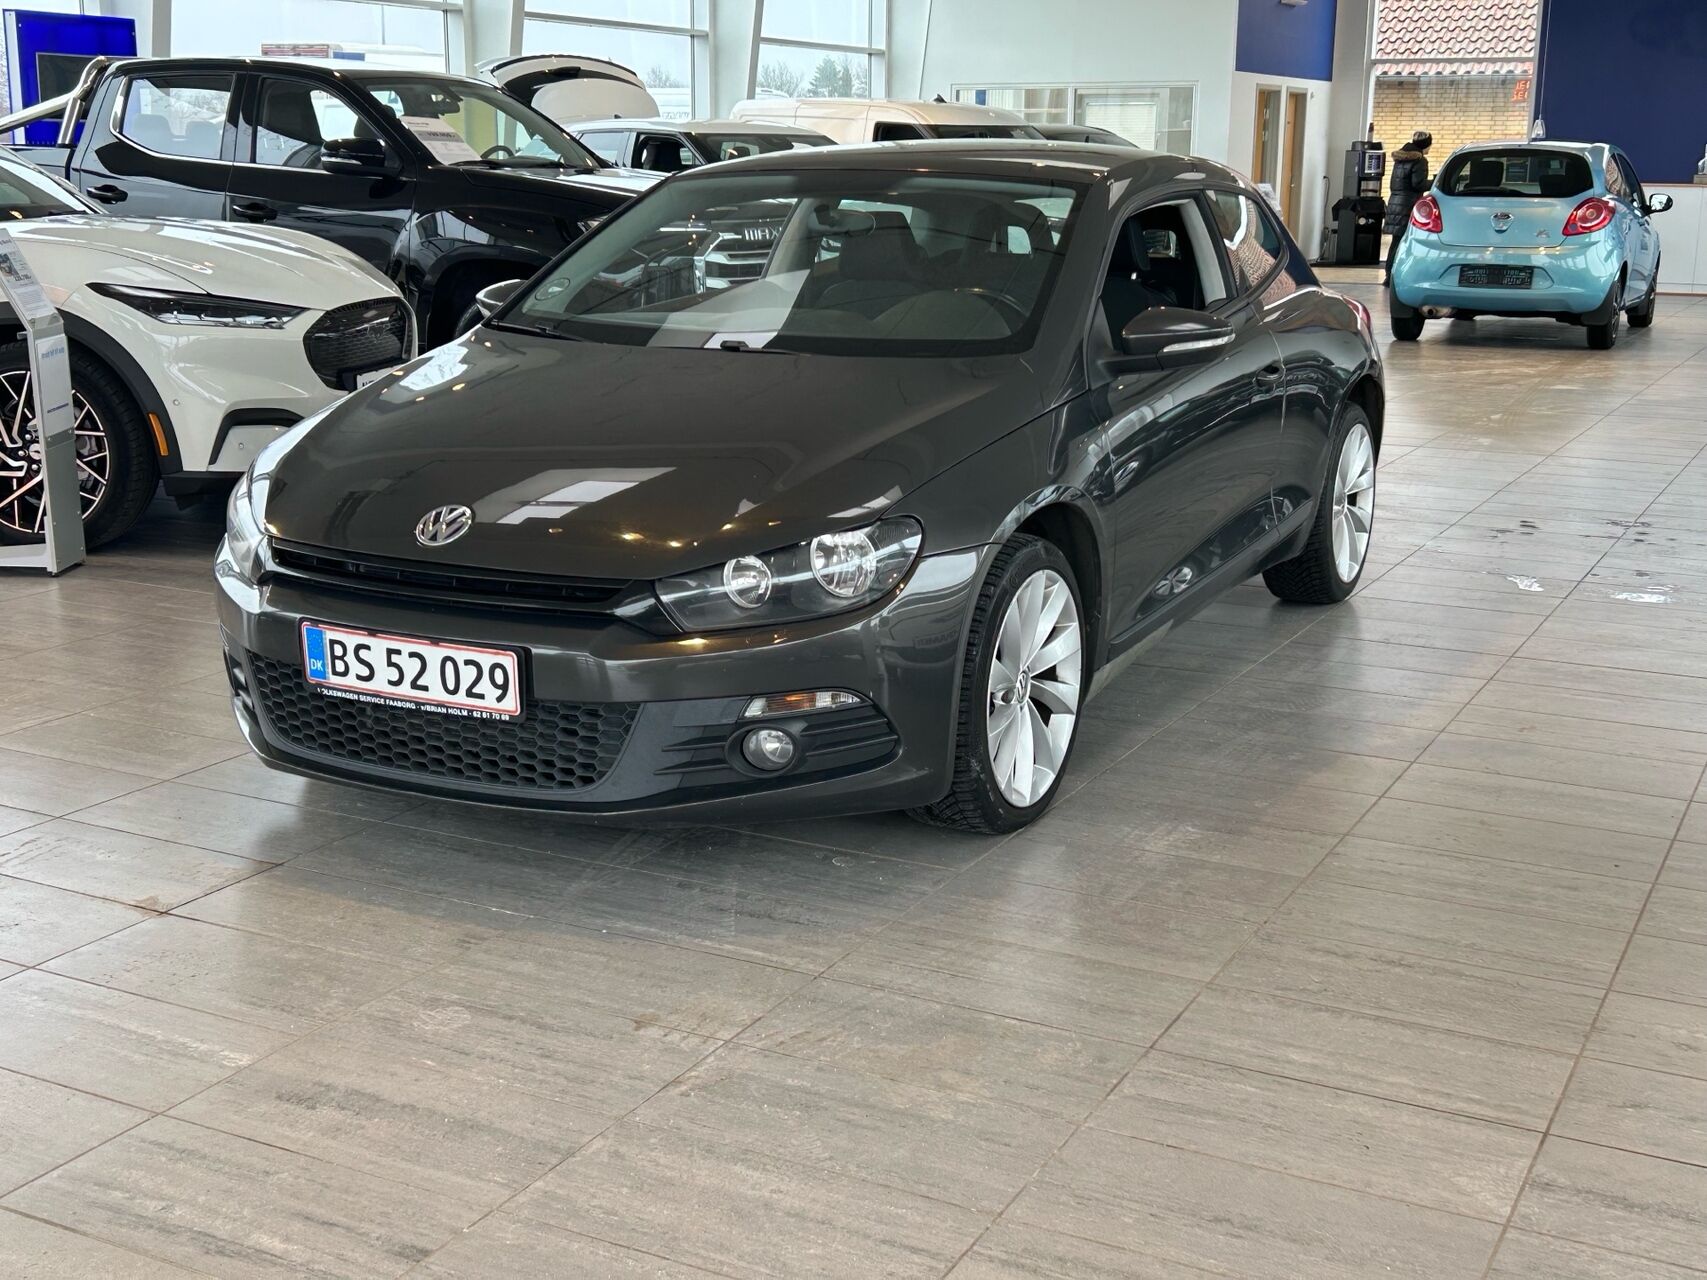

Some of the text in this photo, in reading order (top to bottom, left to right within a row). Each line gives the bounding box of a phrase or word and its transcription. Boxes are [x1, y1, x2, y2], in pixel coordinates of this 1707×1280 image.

[744, 226, 782, 241] MAX
[310, 658, 324, 672] DK
[328, 638, 510, 703] BS 52 029
[359, 694, 385, 705] SERVICE
[386, 698, 416, 709] FAABORG
[448, 708, 468, 716] HOLM
